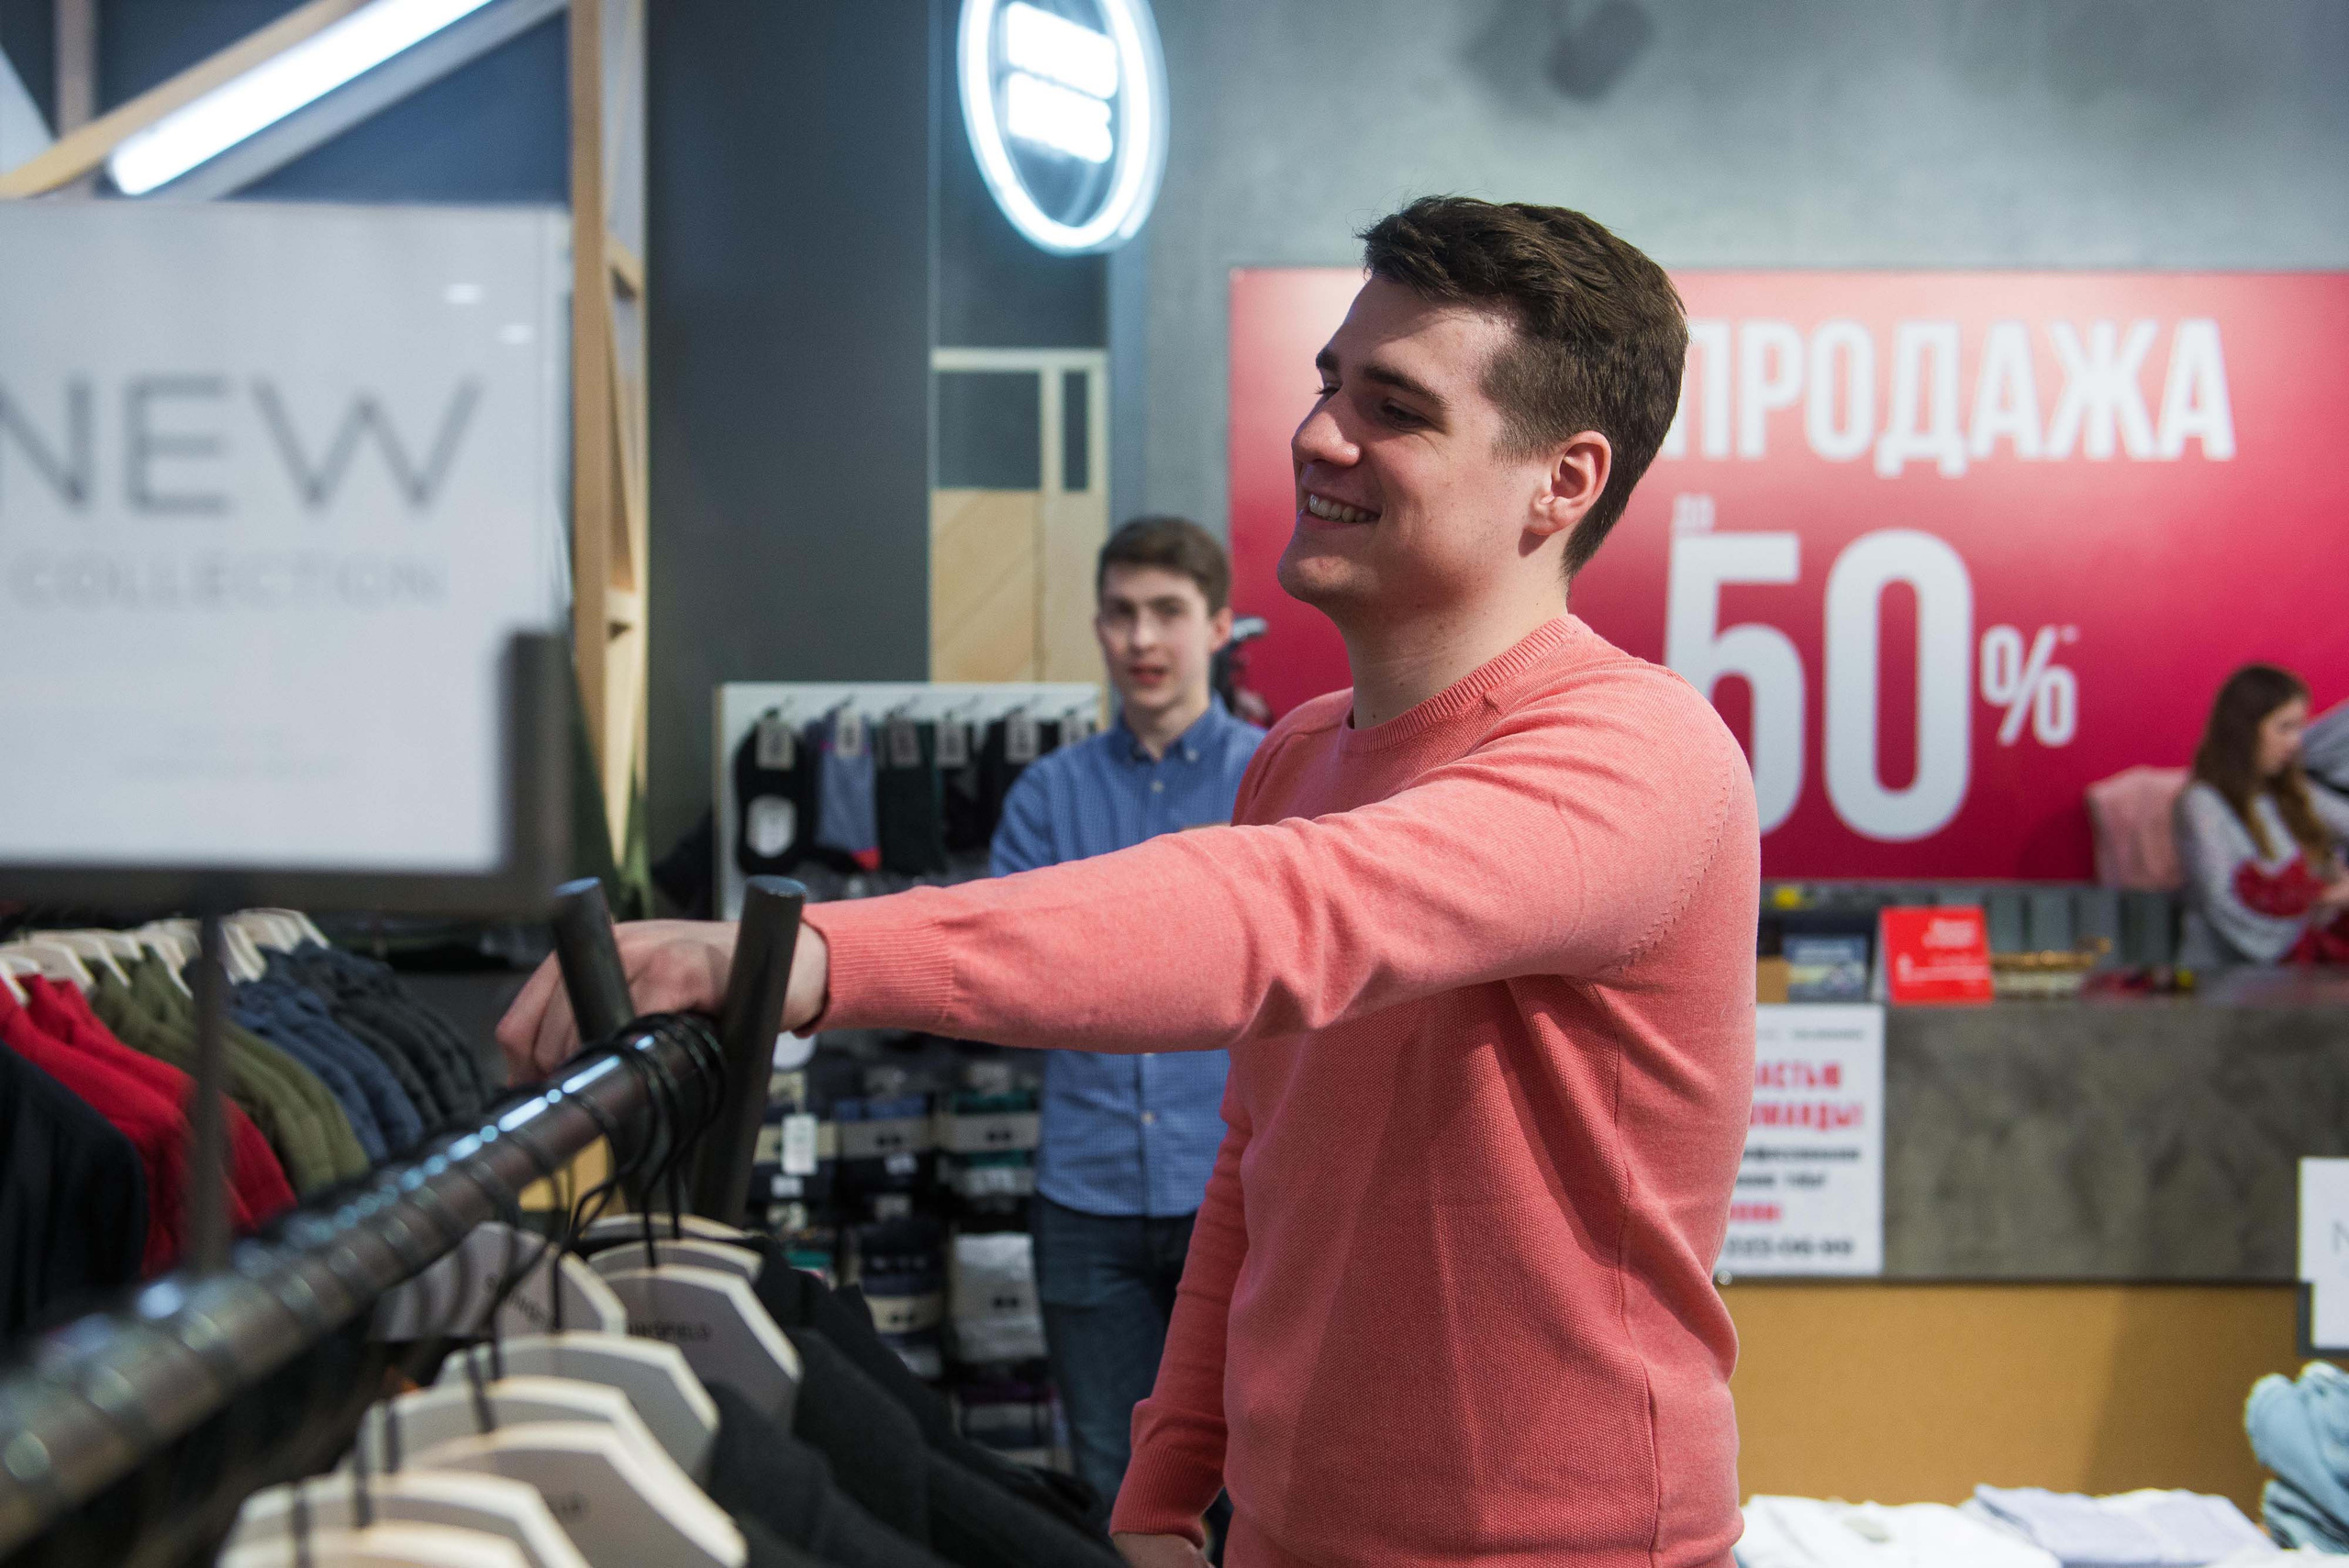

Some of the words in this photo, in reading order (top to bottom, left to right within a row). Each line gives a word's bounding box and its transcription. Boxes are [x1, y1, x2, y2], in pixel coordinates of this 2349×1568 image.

[0, 372, 484, 517] NEW
[1662, 320, 2235, 477] ПРОДАЖА
[8, 550, 448, 611] COLLECTION
